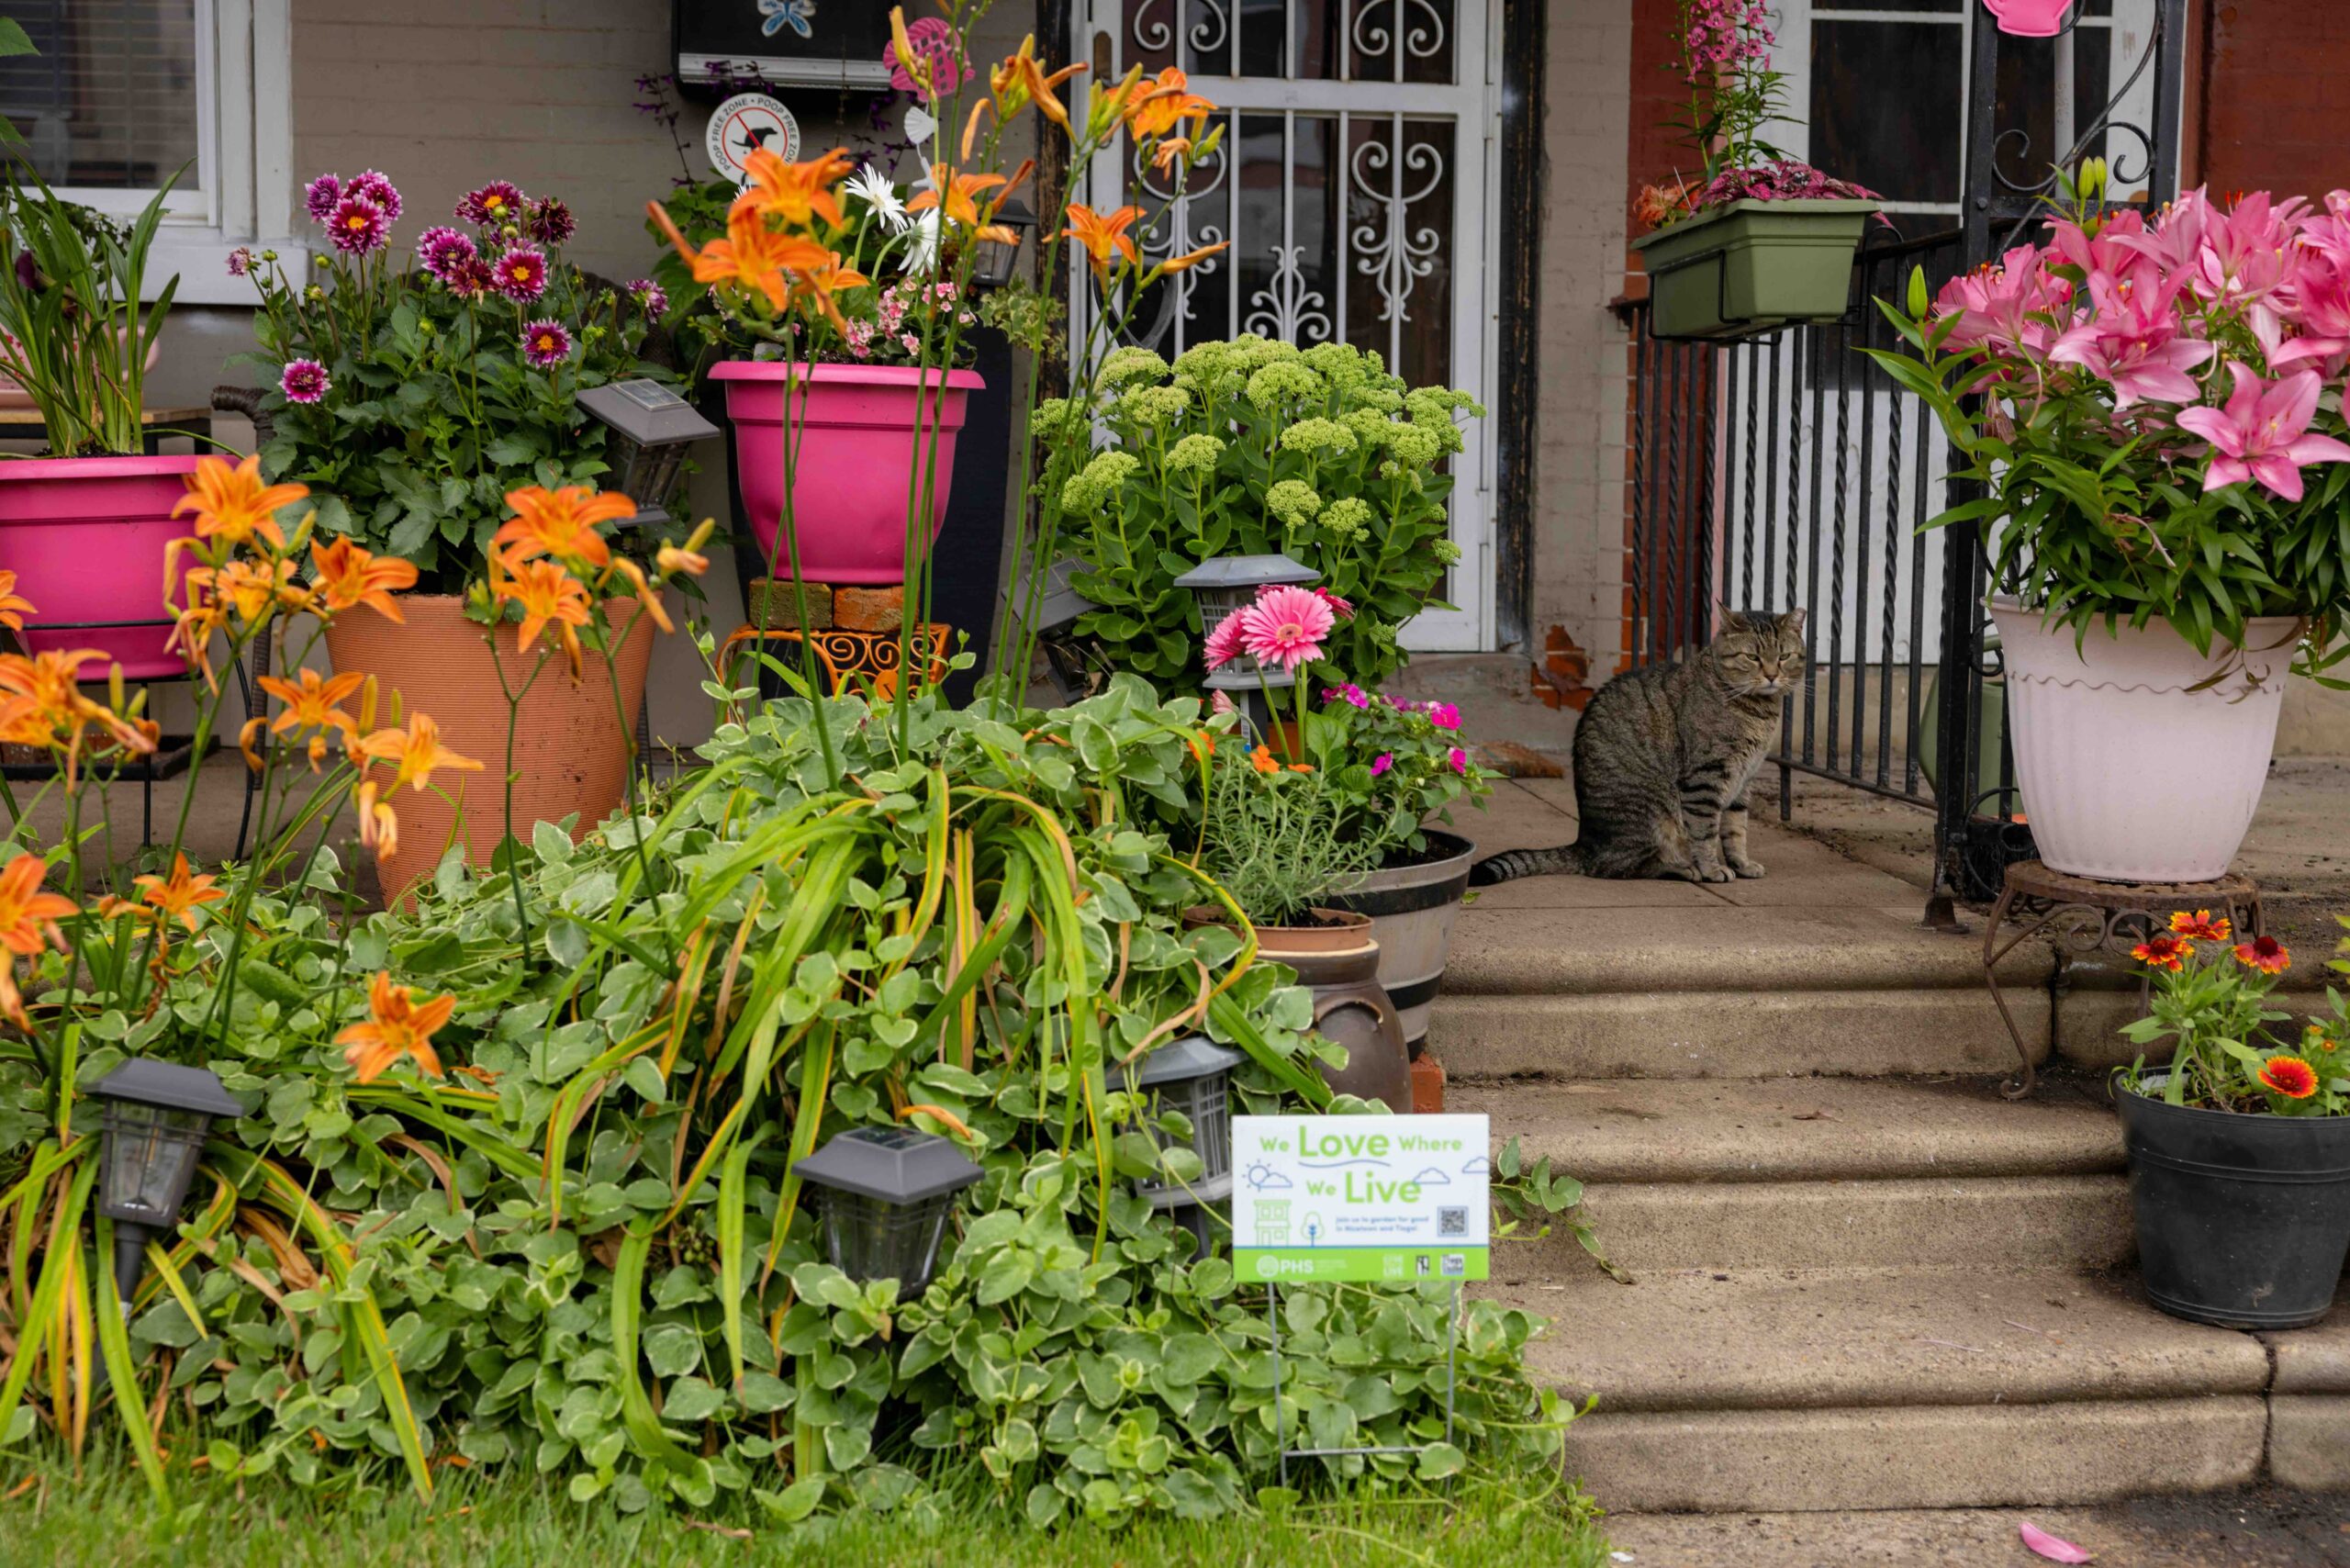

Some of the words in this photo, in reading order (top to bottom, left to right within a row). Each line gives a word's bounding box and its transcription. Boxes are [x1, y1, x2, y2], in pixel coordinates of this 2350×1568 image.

[723, 98, 749, 116] ZONE
[757, 97, 784, 115] POOP
[712, 116, 724, 141] FREE
[783, 115, 797, 140] FREE
[713, 145, 731, 171] POOP
[784, 143, 797, 165] ZON
[1259, 1137, 1290, 1151] We
[1299, 1125, 1390, 1158] Love
[1398, 1136, 1462, 1151] Where
[1306, 1181, 1337, 1196] We
[1345, 1171, 1421, 1204] Live
[1280, 1259, 1314, 1274] PHS
